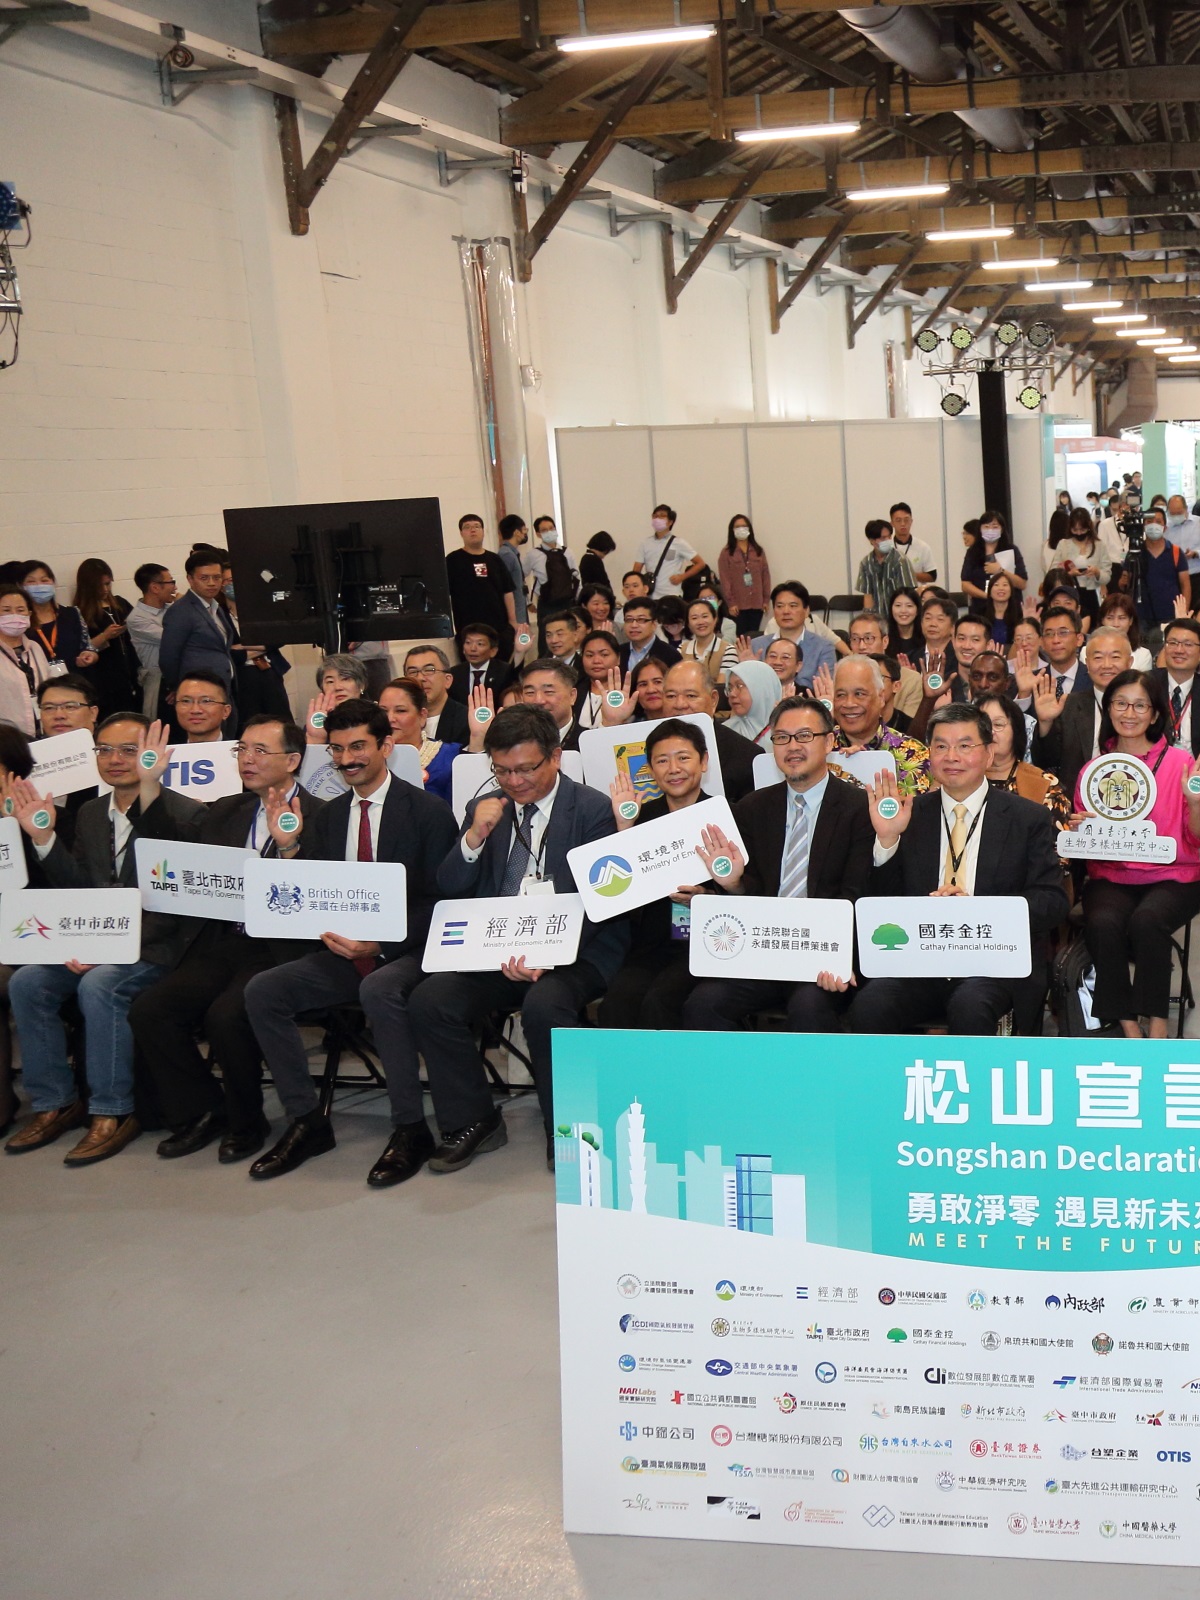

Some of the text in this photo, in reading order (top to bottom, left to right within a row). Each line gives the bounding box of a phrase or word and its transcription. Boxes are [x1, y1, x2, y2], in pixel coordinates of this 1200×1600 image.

[33, 752, 88, 773] 際股份有限公司
[163, 760, 215, 787] TIS
[637, 838, 686, 864] 環境部
[1064, 838, 1170, 852] 生物多樣性研究中心
[641, 854, 681, 874] Ministry of
[183, 886, 245, 901] Taipei City Governme
[308, 887, 380, 901] British Office
[308, 901, 381, 913] 英國在台辦事處
[58, 915, 130, 931] 臺中市政府
[485, 914, 568, 939] 經濟部
[752, 926, 811, 939] 立法院聯合國
[919, 923, 993, 940] 國泰金控
[483, 939, 563, 949] Ministry of Economic Affairs
[751, 939, 841, 954] 永續發展目標策進會
[920, 943, 1019, 954] Cathay Financial Holdings
[897, 1140, 1050, 1177] Songshan
[907, 1190, 1041, 1231] 勇敢淨零
[908, 1232, 989, 1250] MEET
[1015, 1235, 1073, 1252] THE
[817, 1286, 859, 1299] 經濟部
[990, 1294, 1025, 1307] 教育部
[1063, 1293, 1106, 1314] 內政部
[1152, 1297, 1200, 1309] 農業部
[632, 1320, 649, 1329] ICDI
[826, 1327, 870, 1338] 臺北市政府
[912, 1328, 954, 1339] 國泰金控
[1003, 1336, 1074, 1348] 帛琉共和國大使館
[1118, 1340, 1190, 1352] 諾魯共和國大使館
[734, 1362, 799, 1372] 交通部中央氣象署
[1079, 1375, 1164, 1388] 經濟部國際貿易署
[686, 1393, 757, 1405] 國立公共資訊圖書館
[893, 1405, 946, 1416] 南島民族論壇
[975, 1405, 1026, 1418] 新北市政府
[1071, 1410, 1117, 1420] 臺中市政府
[642, 1425, 695, 1441] 中鋼公司
[735, 1430, 843, 1447] 台灣糖業股份有限公司
[881, 1437, 953, 1449] 台灣自來水公司
[990, 1441, 1042, 1453] 臺銀證券
[1090, 1448, 1139, 1458] 台塑企業
[1156, 1450, 1192, 1463] OTIS
[640, 1459, 707, 1472] 臺灣氣候服務聯盟
[853, 1473, 919, 1484] 財團法人台灣電信協會
[958, 1476, 1027, 1489] 中華經濟研究院
[1061, 1480, 1179, 1494] 臺大先進公共運輸研究中心
[1122, 1520, 1177, 1533] 中國醫藥大學
